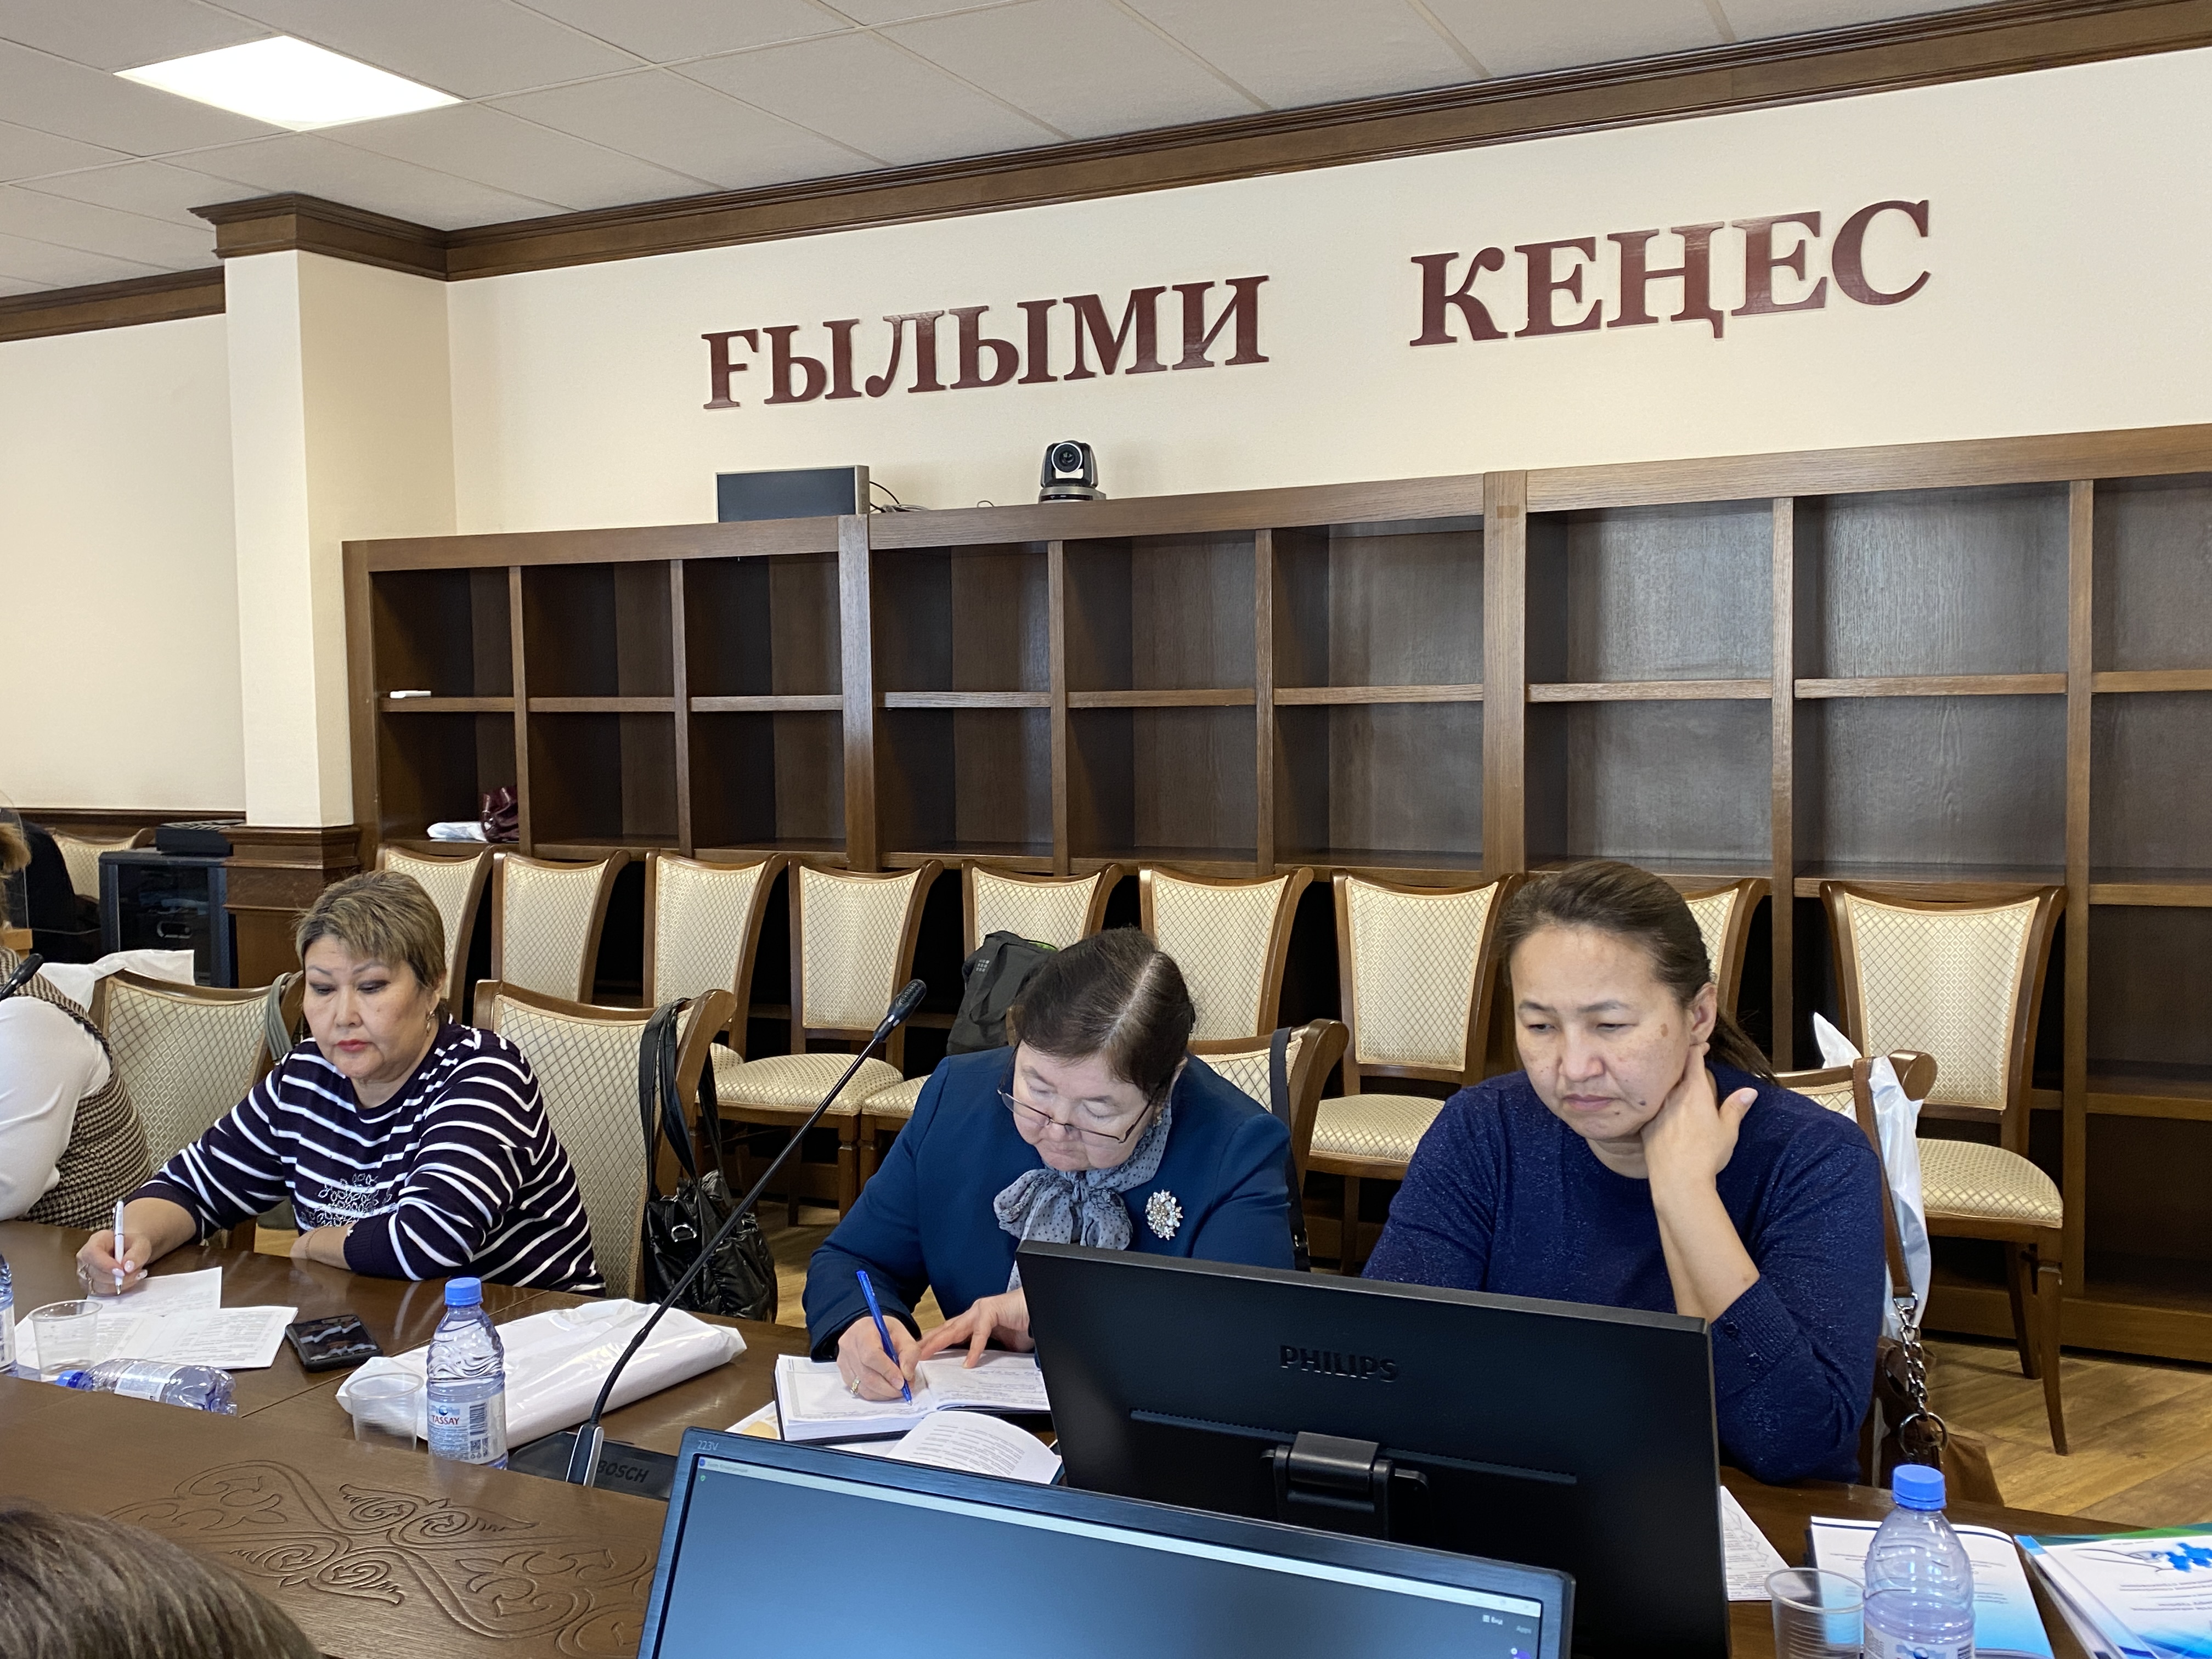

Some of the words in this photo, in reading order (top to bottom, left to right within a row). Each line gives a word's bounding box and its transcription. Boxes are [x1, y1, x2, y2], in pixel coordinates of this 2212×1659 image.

[1409, 199, 1931, 340] КЕҢЕС
[1280, 1345, 1398, 1383] PHILIPS
[431, 1414, 460, 1425] TASSAY
[697, 1440, 719, 1451] 223V
[596, 1459, 650, 1483] BOSCH
